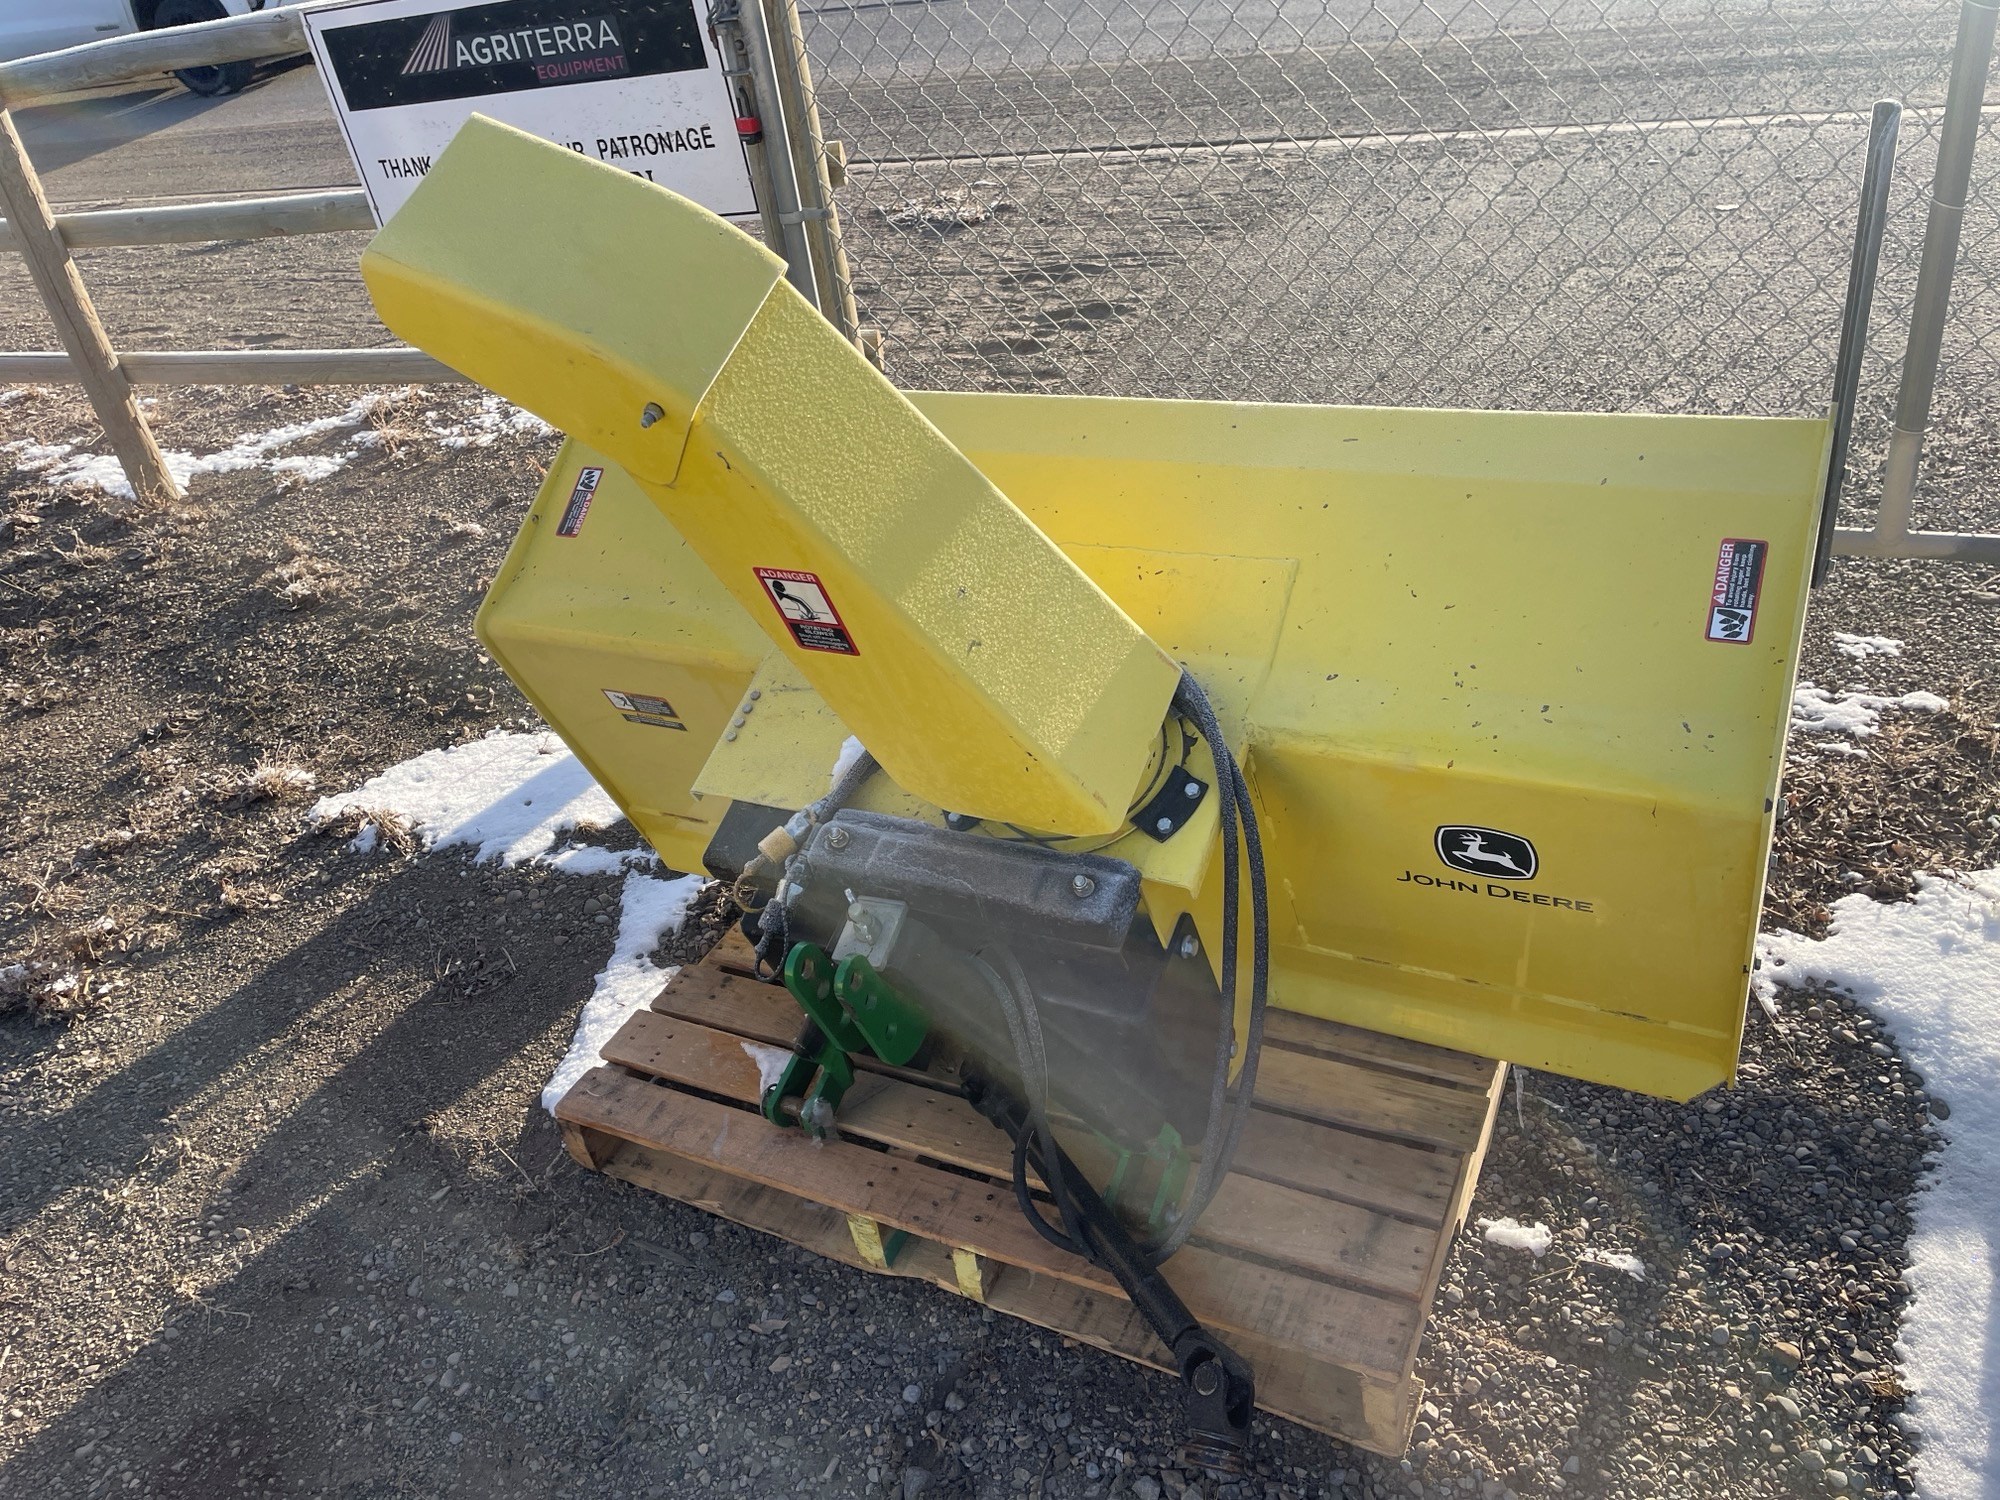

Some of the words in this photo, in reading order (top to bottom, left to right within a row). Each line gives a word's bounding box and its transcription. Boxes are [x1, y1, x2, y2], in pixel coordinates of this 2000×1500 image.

[456, 19, 620, 68] AGRITERRA
[536, 55, 624, 80] EQUIPMENT
[378, 155, 432, 179] THANK
[596, 125, 716, 160] PATRONAGE
[572, 501, 590, 535] DANGER
[1715, 543, 1735, 591] DANGER
[1747, 544, 1757, 566] clothing
[768, 569, 816, 583] DANGER
[1725, 599, 1732, 607] To
[1730, 567, 1739, 582] injury
[1734, 586, 1743, 607] rotating
[1740, 554, 1748, 567] keep
[1396, 870, 1478, 894] JOHN
[1487, 884, 1594, 913] DEERE
